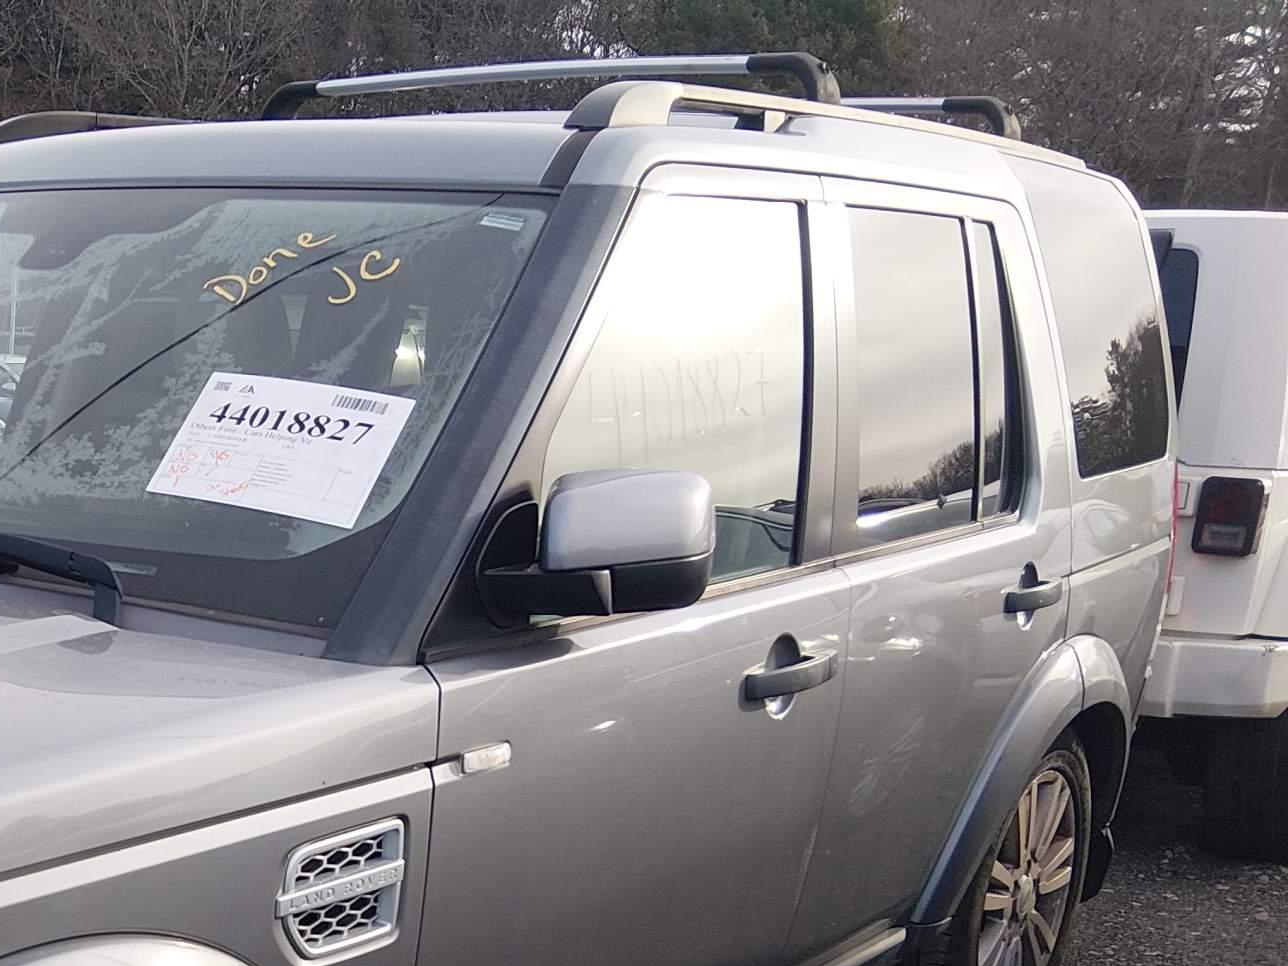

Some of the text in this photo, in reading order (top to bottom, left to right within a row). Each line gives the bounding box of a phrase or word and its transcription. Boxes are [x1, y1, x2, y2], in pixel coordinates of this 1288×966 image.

[203, 232, 337, 305] Done
[327, 250, 401, 304] JC
[209, 402, 375, 445] 44018827
[288, 867, 399, 912] LAND ROVER
